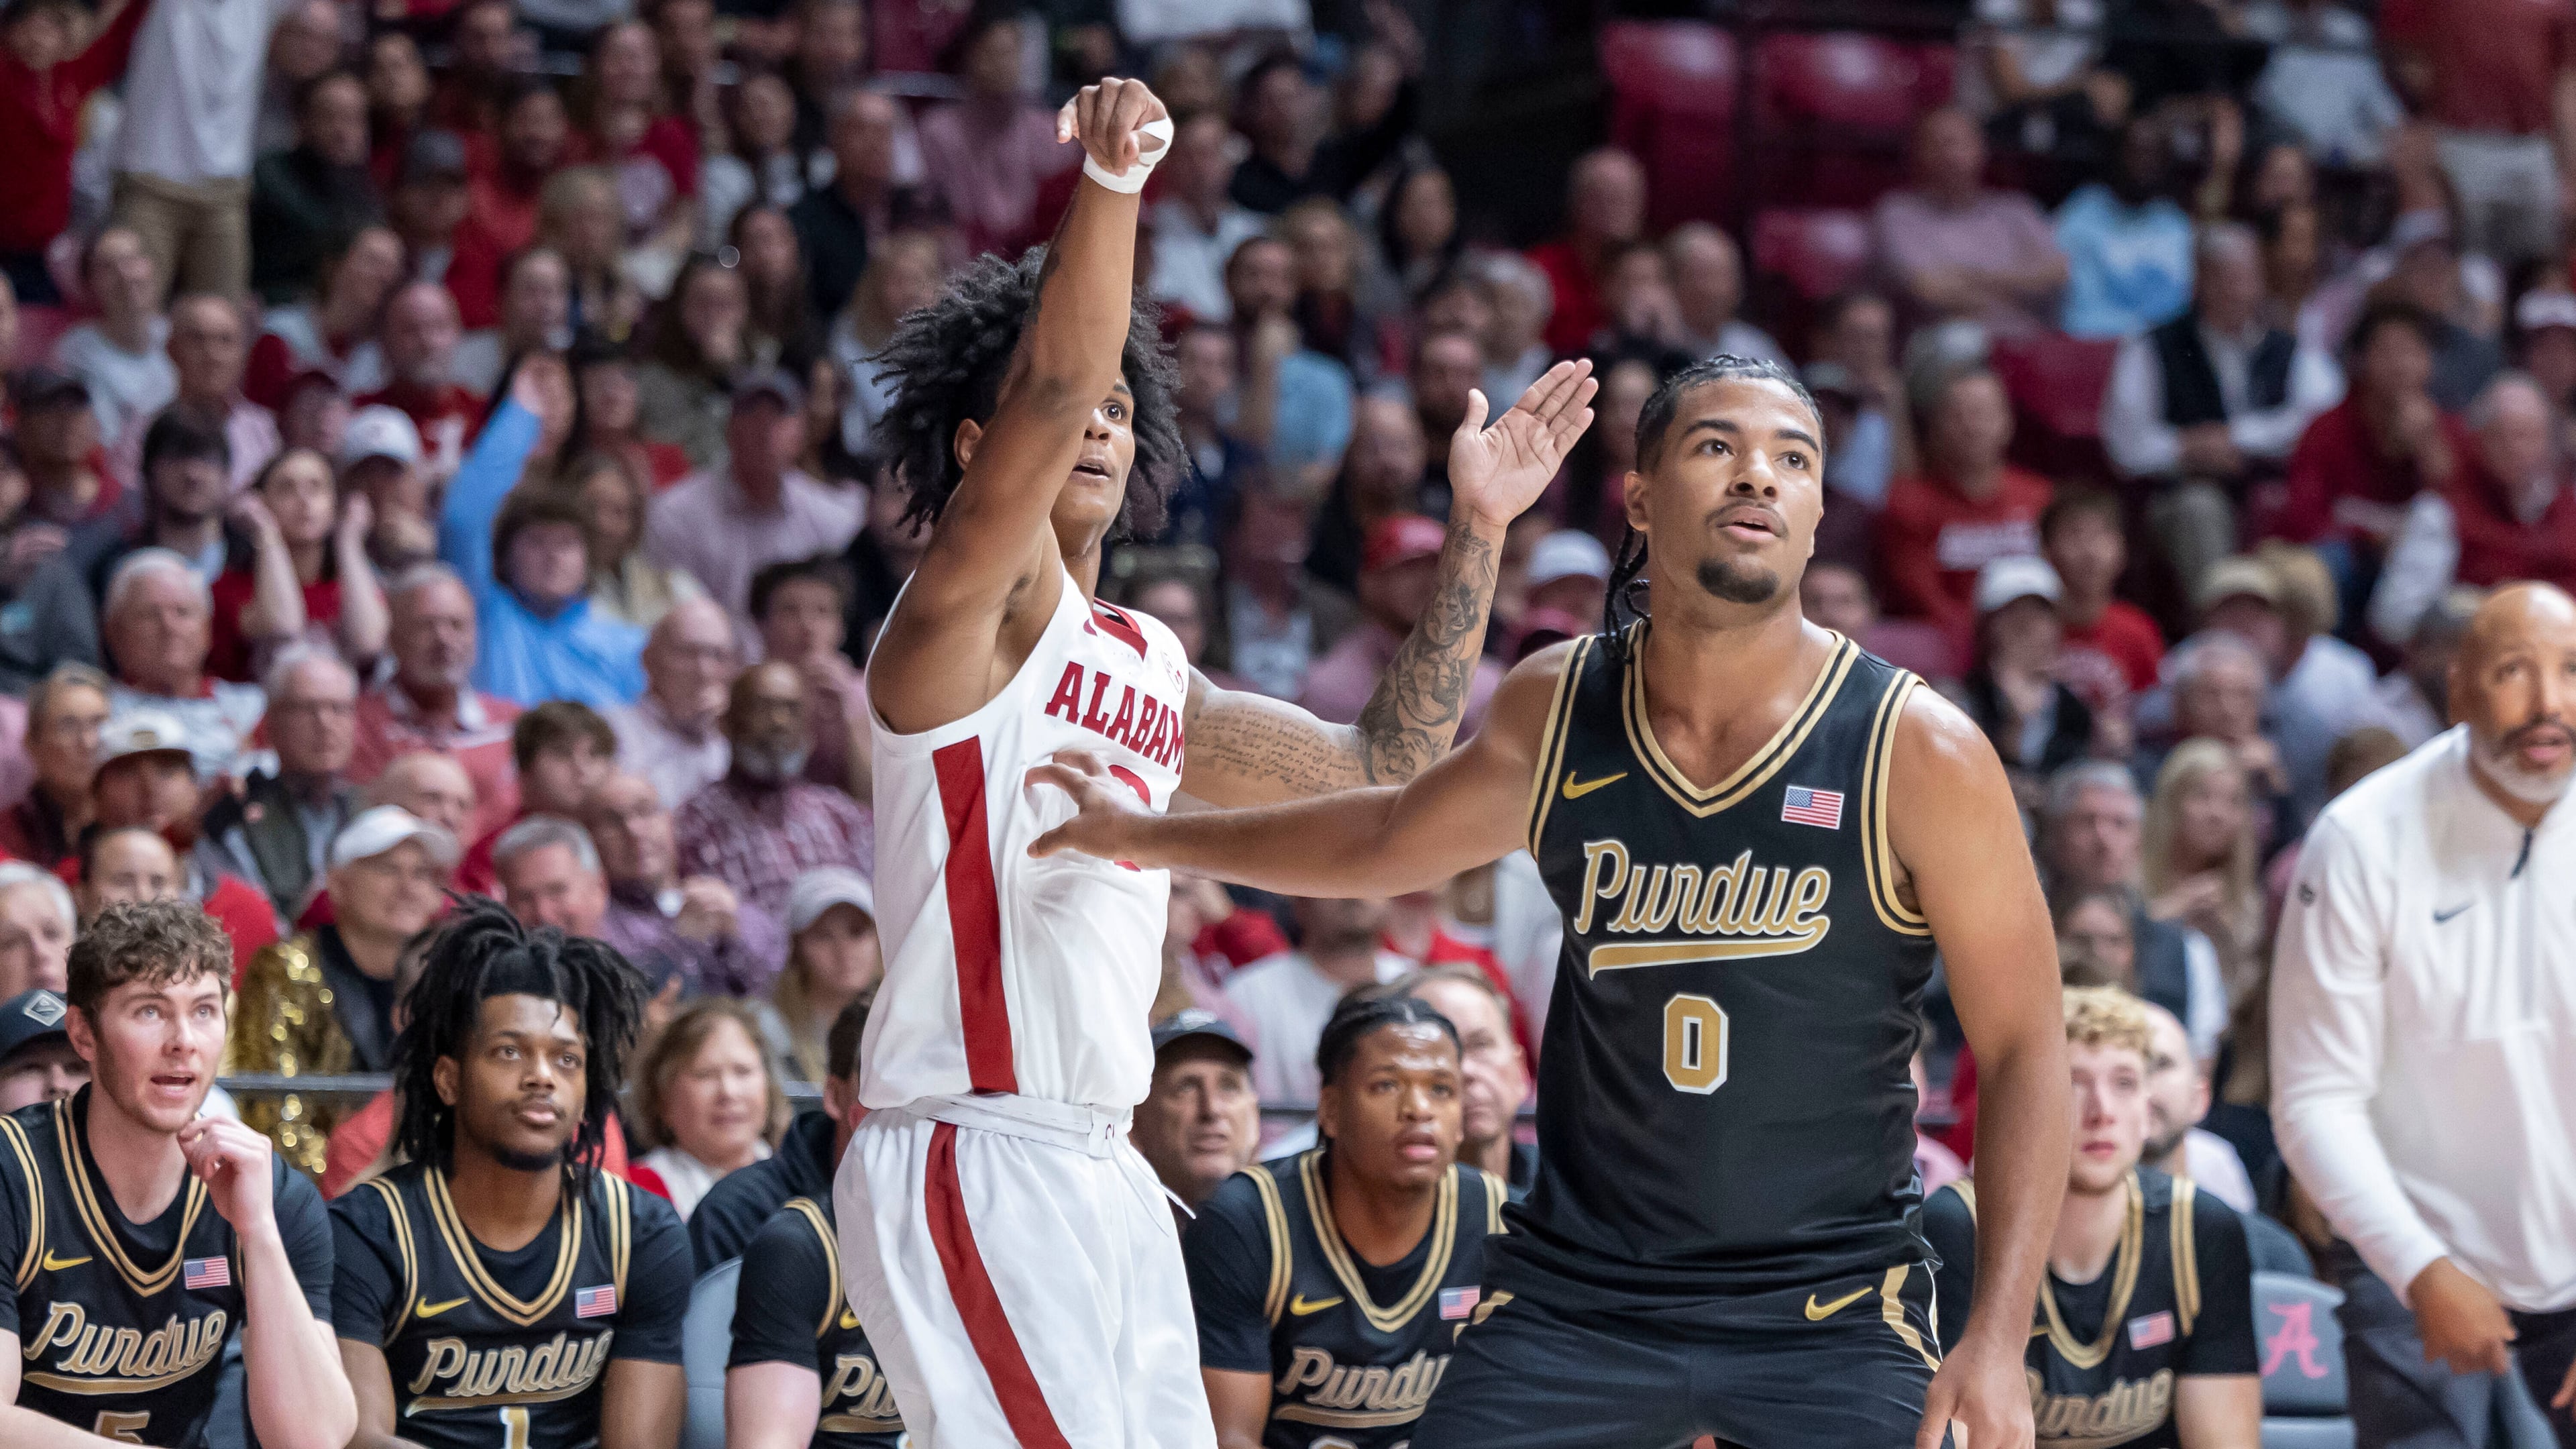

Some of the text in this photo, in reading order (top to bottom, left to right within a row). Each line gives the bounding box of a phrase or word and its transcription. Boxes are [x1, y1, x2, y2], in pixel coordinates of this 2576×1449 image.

[1044, 661, 1185, 775] ALABAM
[1574, 839, 1831, 935] Purdue
[1664, 994, 1728, 1095] 0
[23, 1301, 227, 1377] Purdue
[408, 1328, 614, 1397] Purdue
[1275, 1346, 1453, 1409] Purdu
[498, 1406, 532, 1449] 1
